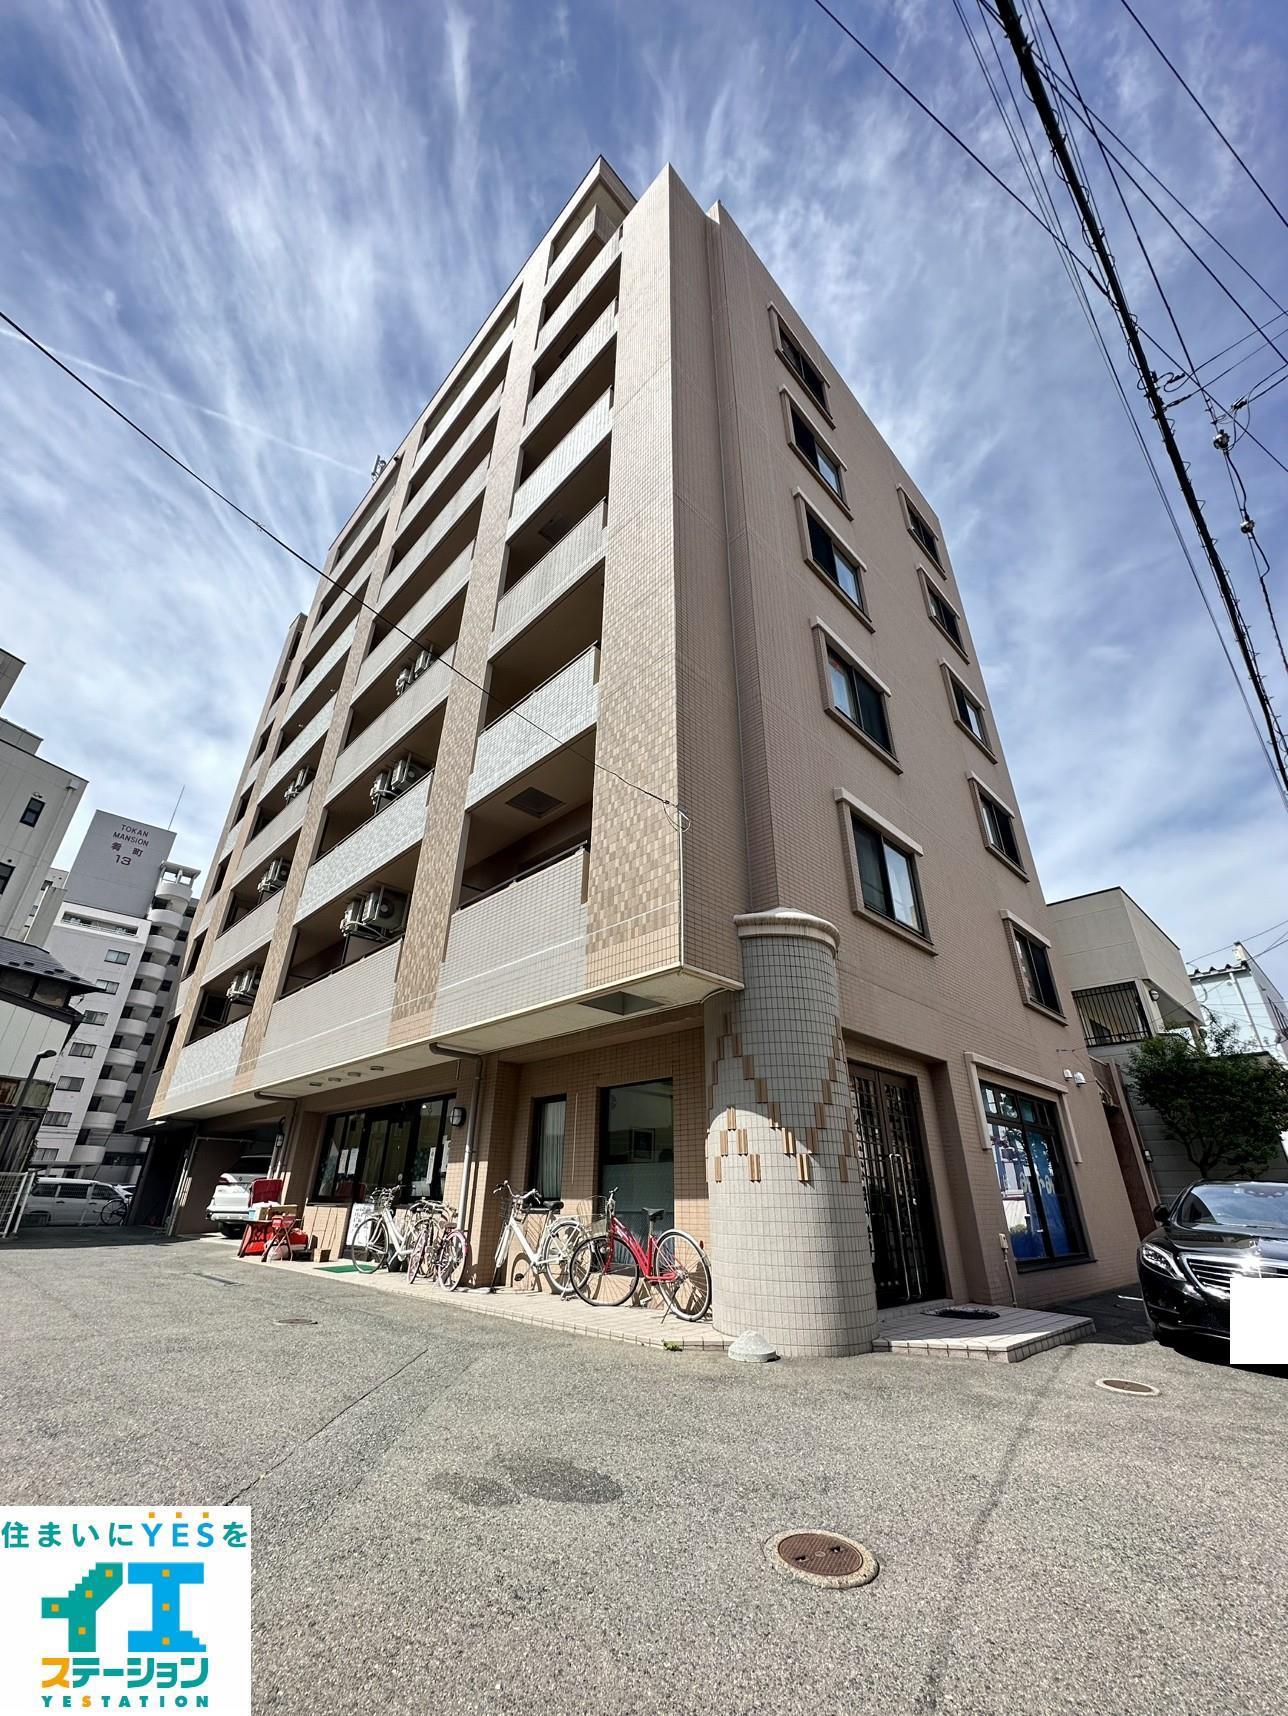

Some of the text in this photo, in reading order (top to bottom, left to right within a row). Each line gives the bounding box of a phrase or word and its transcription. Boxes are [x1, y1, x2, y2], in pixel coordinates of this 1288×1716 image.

[121, 824, 149, 837] TOKAN
[113, 832, 149, 847] MANSION
[115, 854, 131, 866] 13
